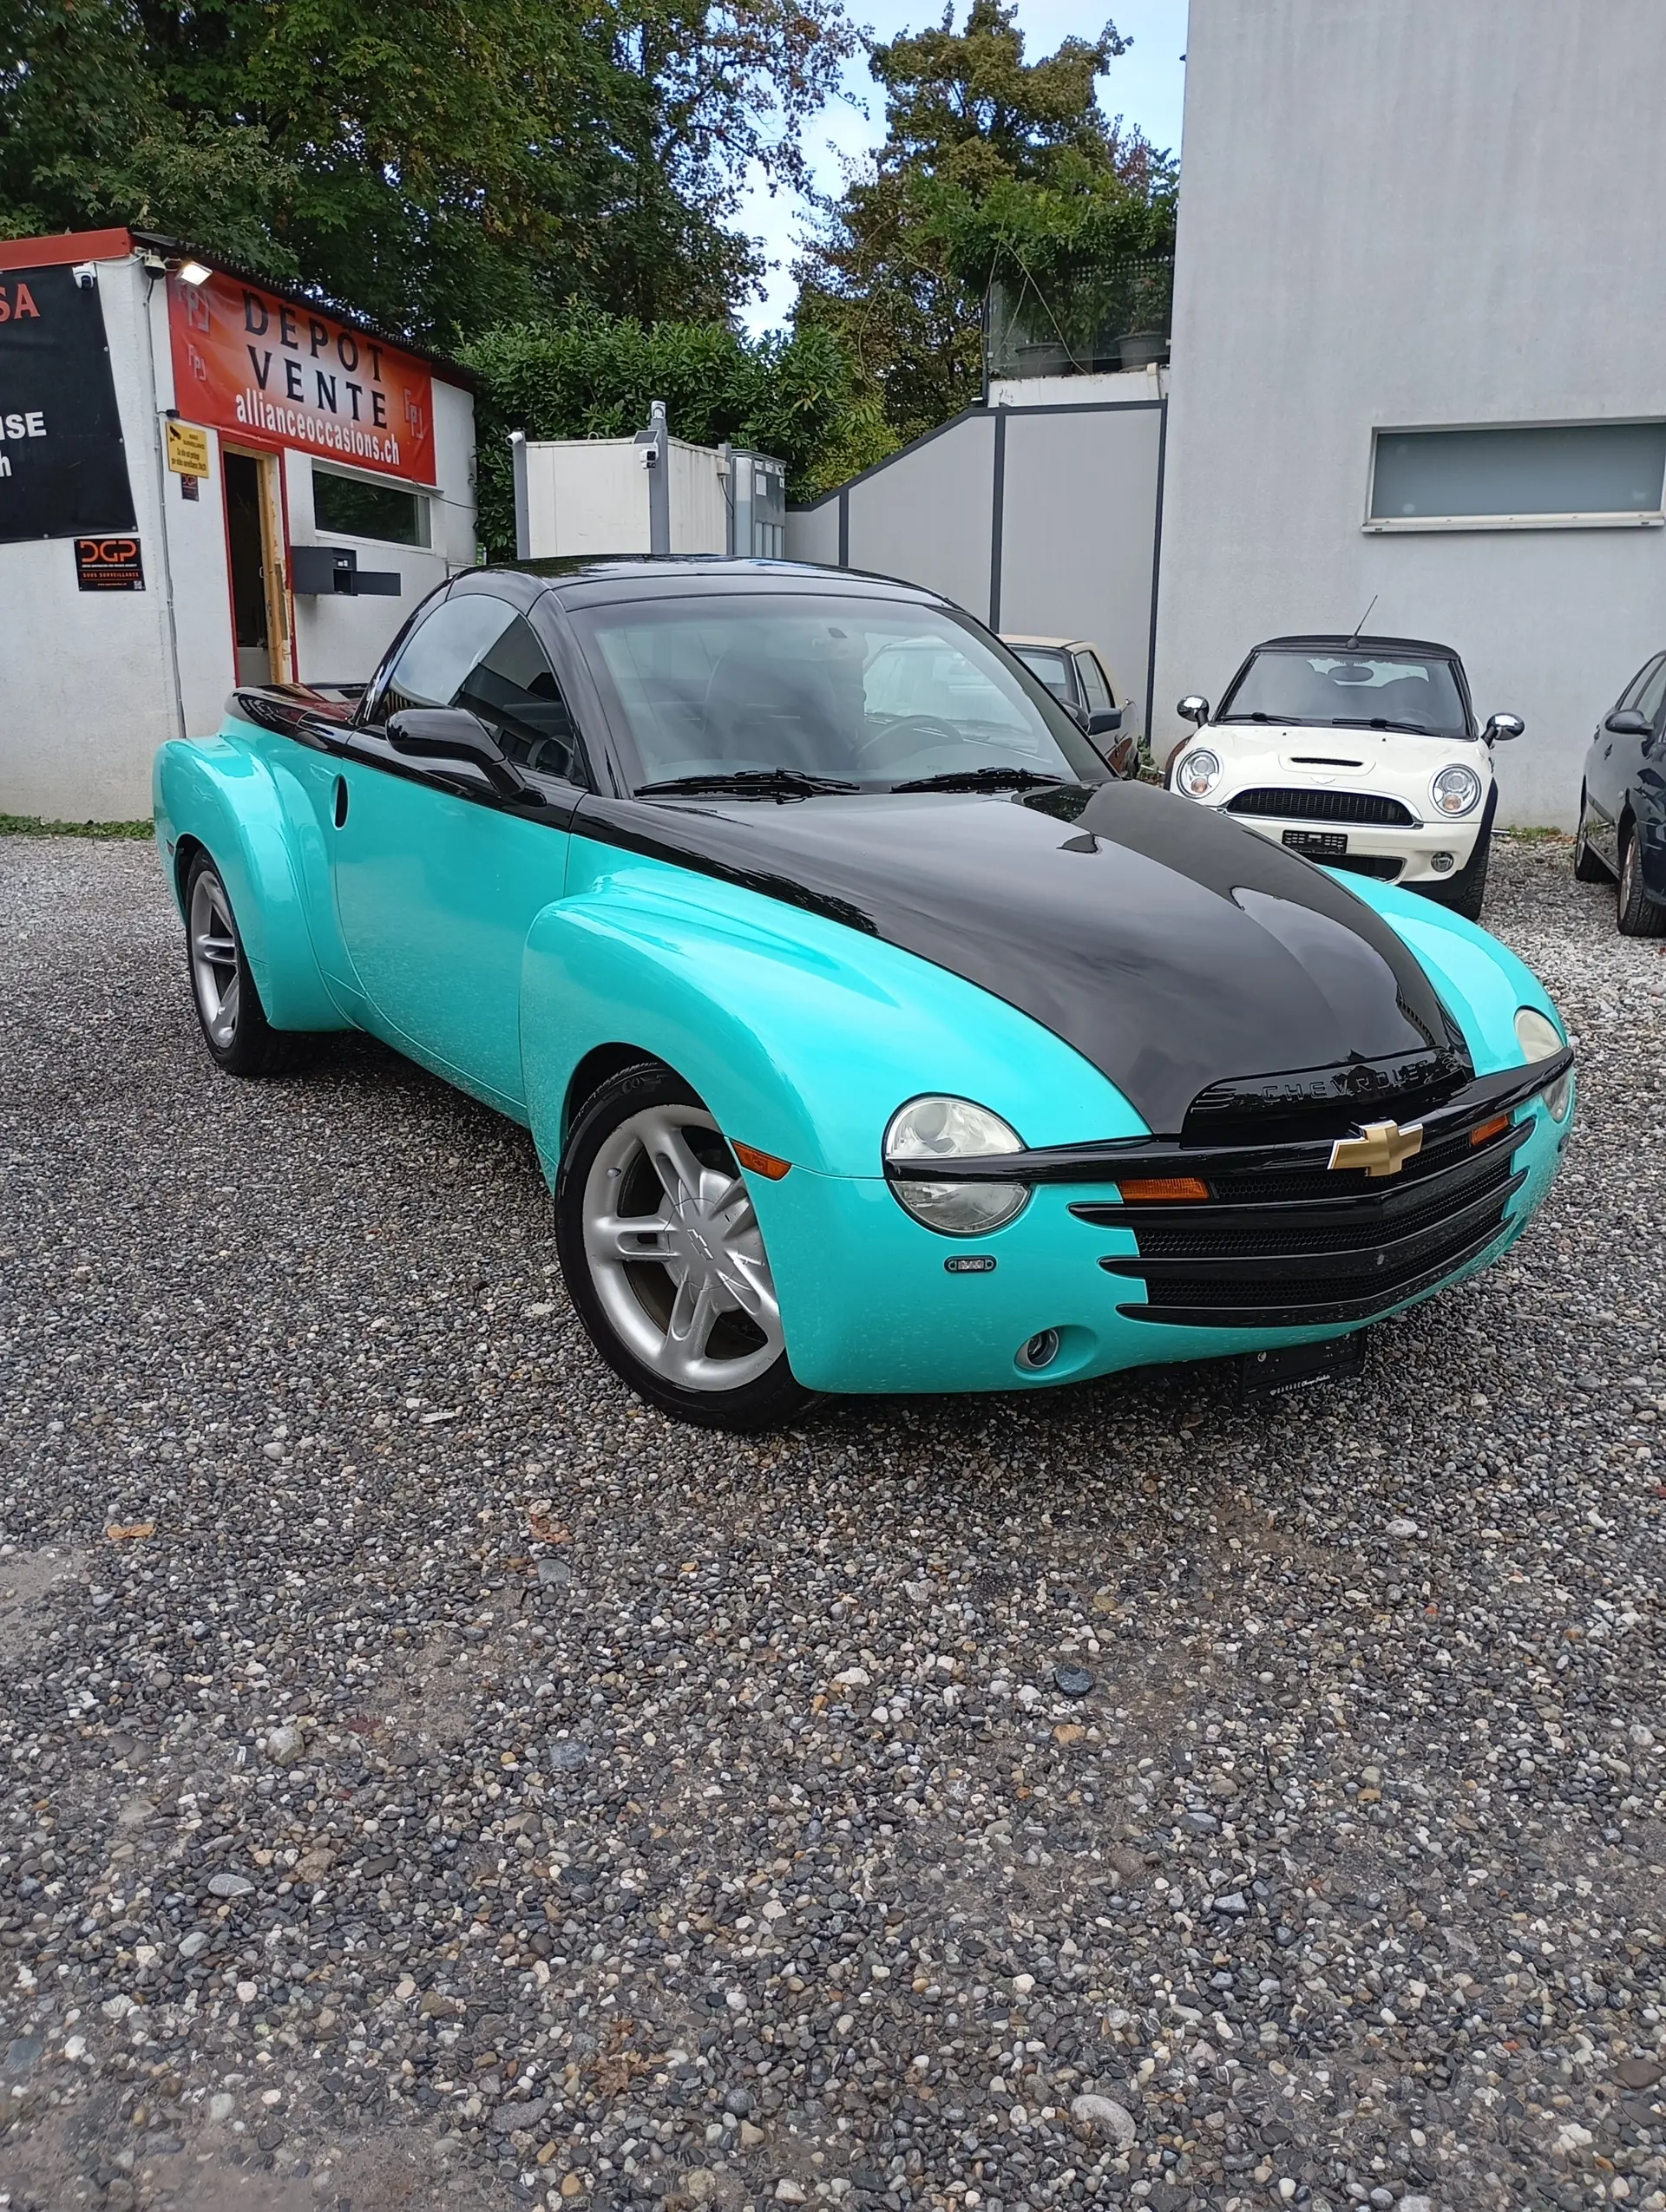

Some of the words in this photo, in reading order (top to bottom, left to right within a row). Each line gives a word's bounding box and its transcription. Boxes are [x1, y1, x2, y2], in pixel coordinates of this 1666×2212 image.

[246, 344, 387, 429] VENTE
[235, 388, 400, 465] allianceoccasions.ch
[80, 540, 136, 562] DGP
[1263, 1059, 1430, 1103] CHEVROLET
